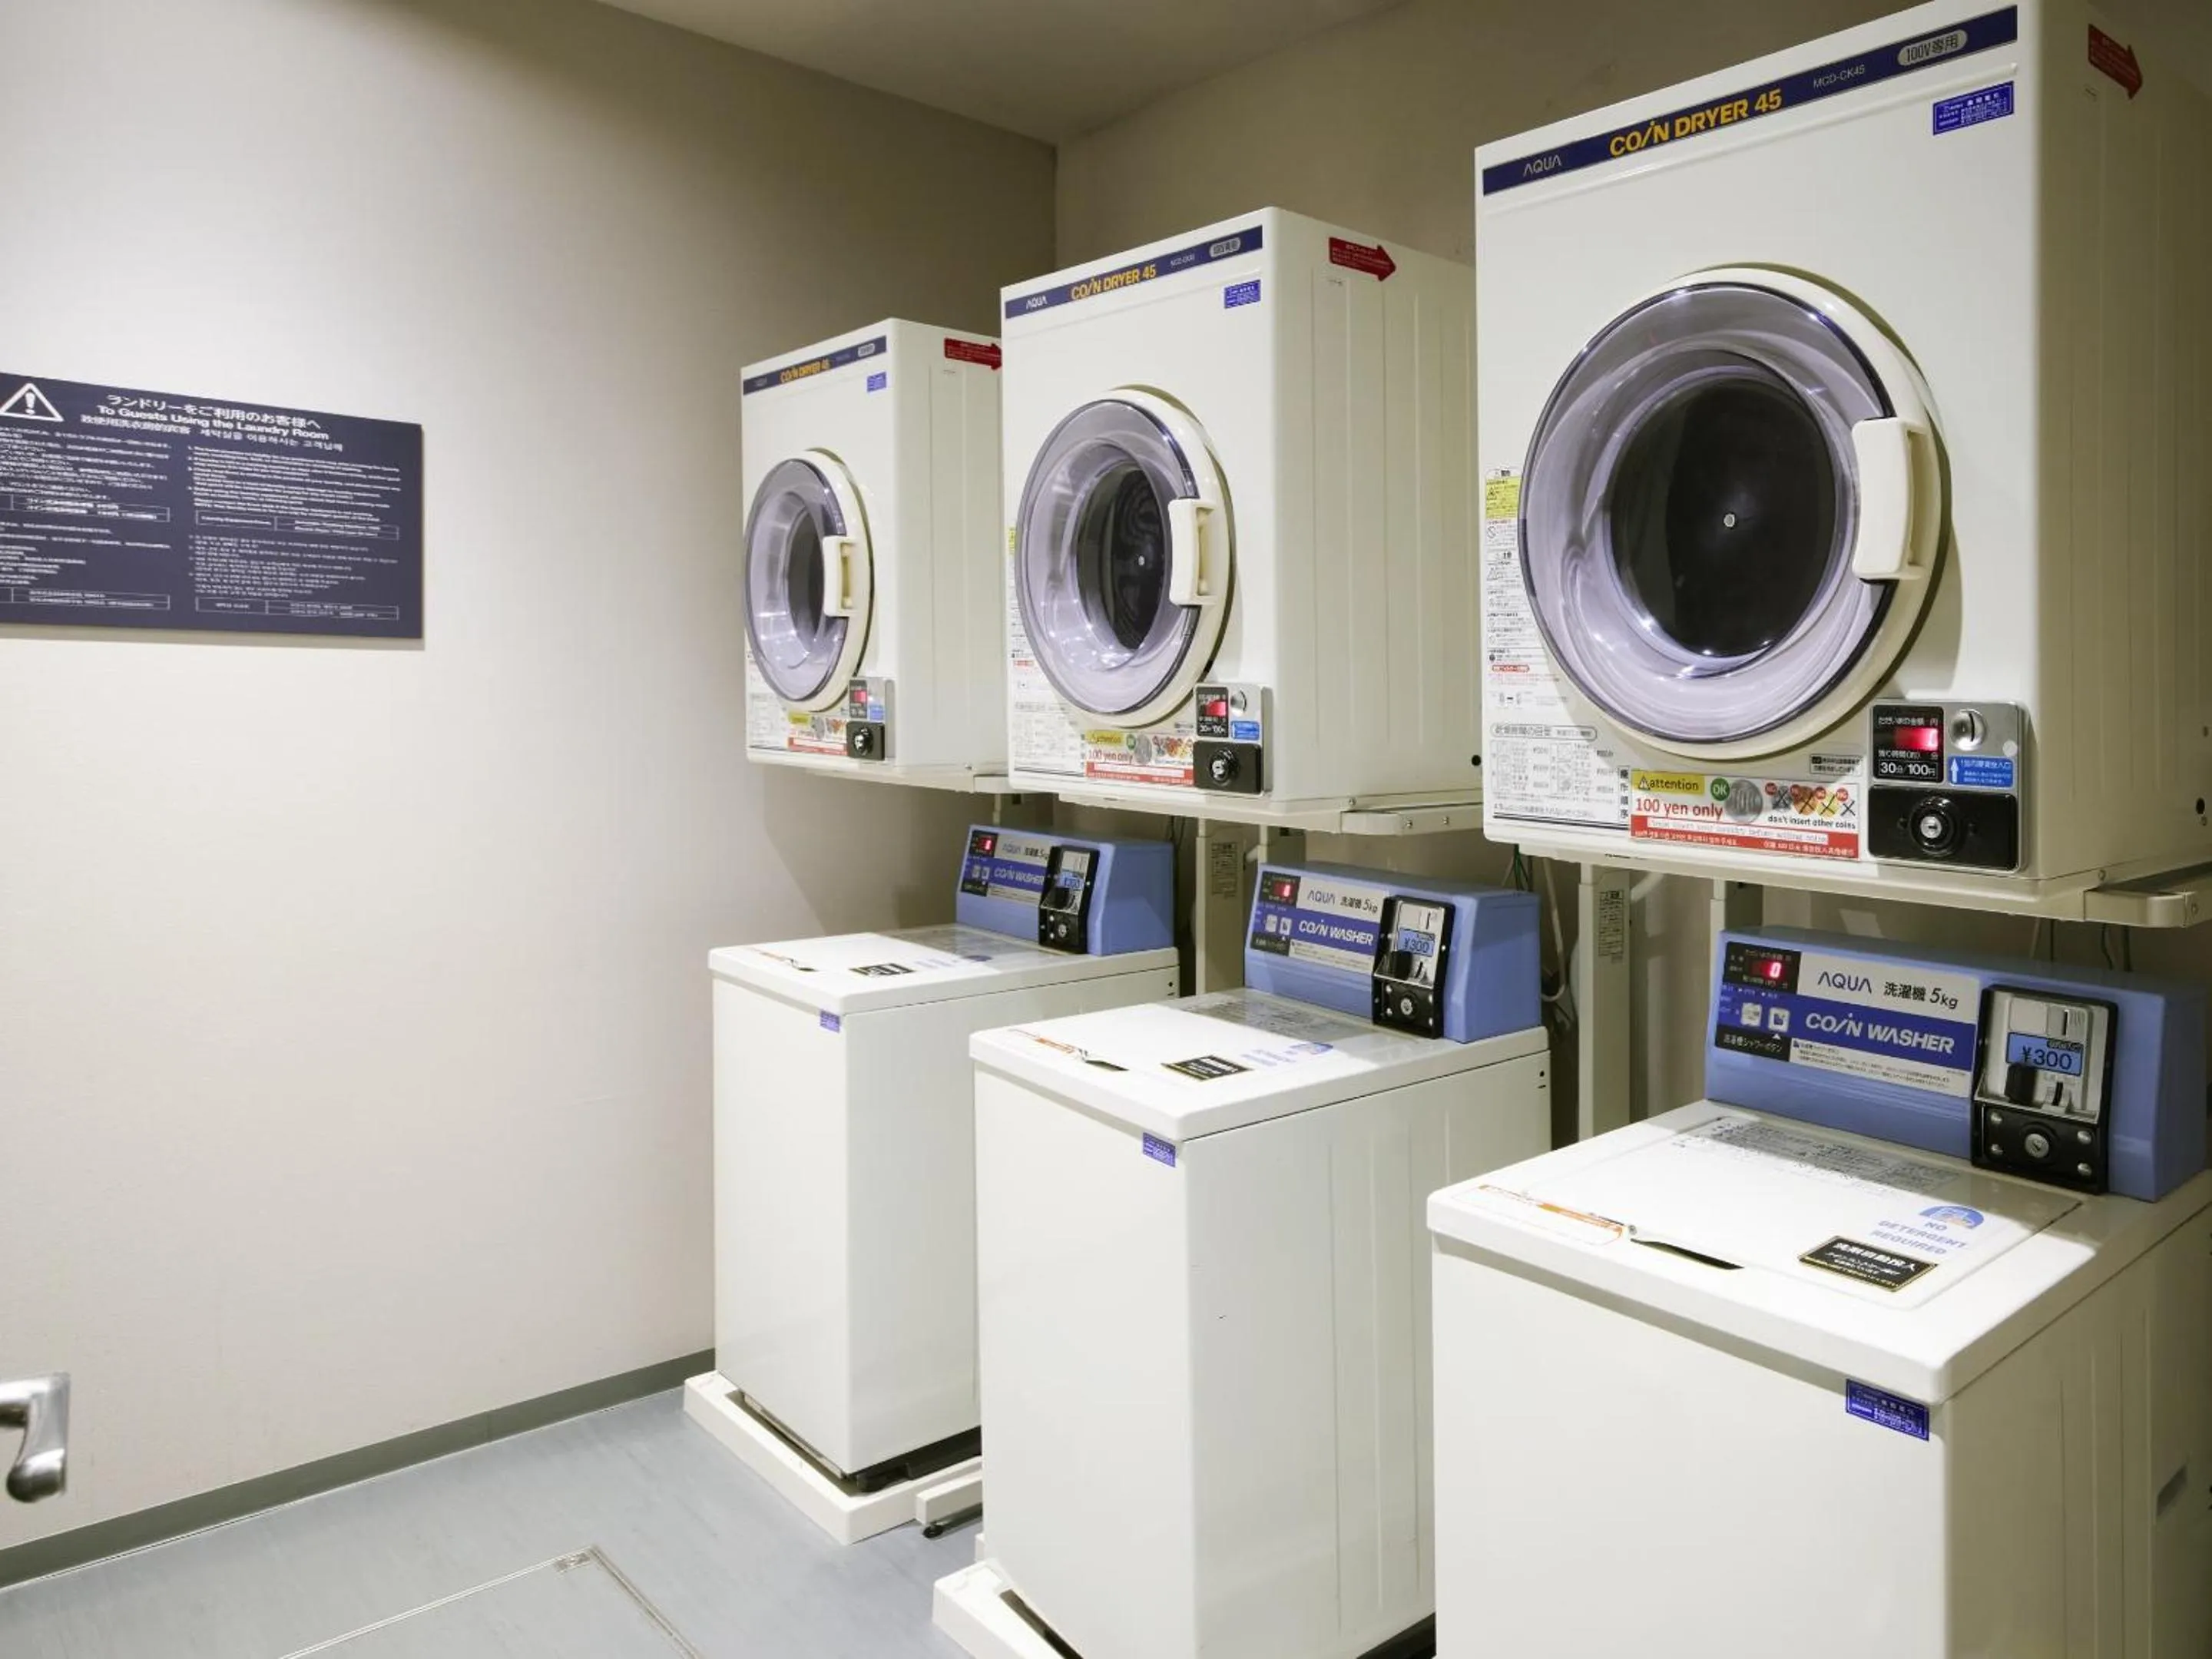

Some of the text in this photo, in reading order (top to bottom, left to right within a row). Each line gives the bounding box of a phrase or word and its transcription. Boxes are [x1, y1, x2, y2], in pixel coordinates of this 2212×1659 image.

[1674, 99, 1749, 138] DRYER
[1755, 89, 1782, 112] 45
[1523, 154, 1562, 177] AQUA
[1104, 270, 1140, 291] DRYER
[1142, 264, 1156, 280] 45
[97, 405, 329, 440] To Guests Using the Laundry Room
[1650, 777, 1699, 791] attention
[1713, 785, 1727, 795] OK
[1636, 798, 1723, 820] 100 yen only
[1767, 815, 1856, 830] don't insert other coins
[1307, 886, 1335, 906] AQUA
[1330, 926, 1374, 945] WASHER
[1403, 936, 1430, 954] ¥300
[1770, 962, 1782, 979] 0
[1817, 971, 1872, 995] AQUA
[1884, 982, 1959, 1011] 洗濯機 5kg
[1806, 1012, 1955, 1055] COIN WASHER
[2022, 1045, 2072, 1071] ¥300
[1878, 1220, 1967, 1248] DETERGENT
[1924, 1221, 1948, 1231] NO
[1868, 1230, 1947, 1255] REQUIRED
